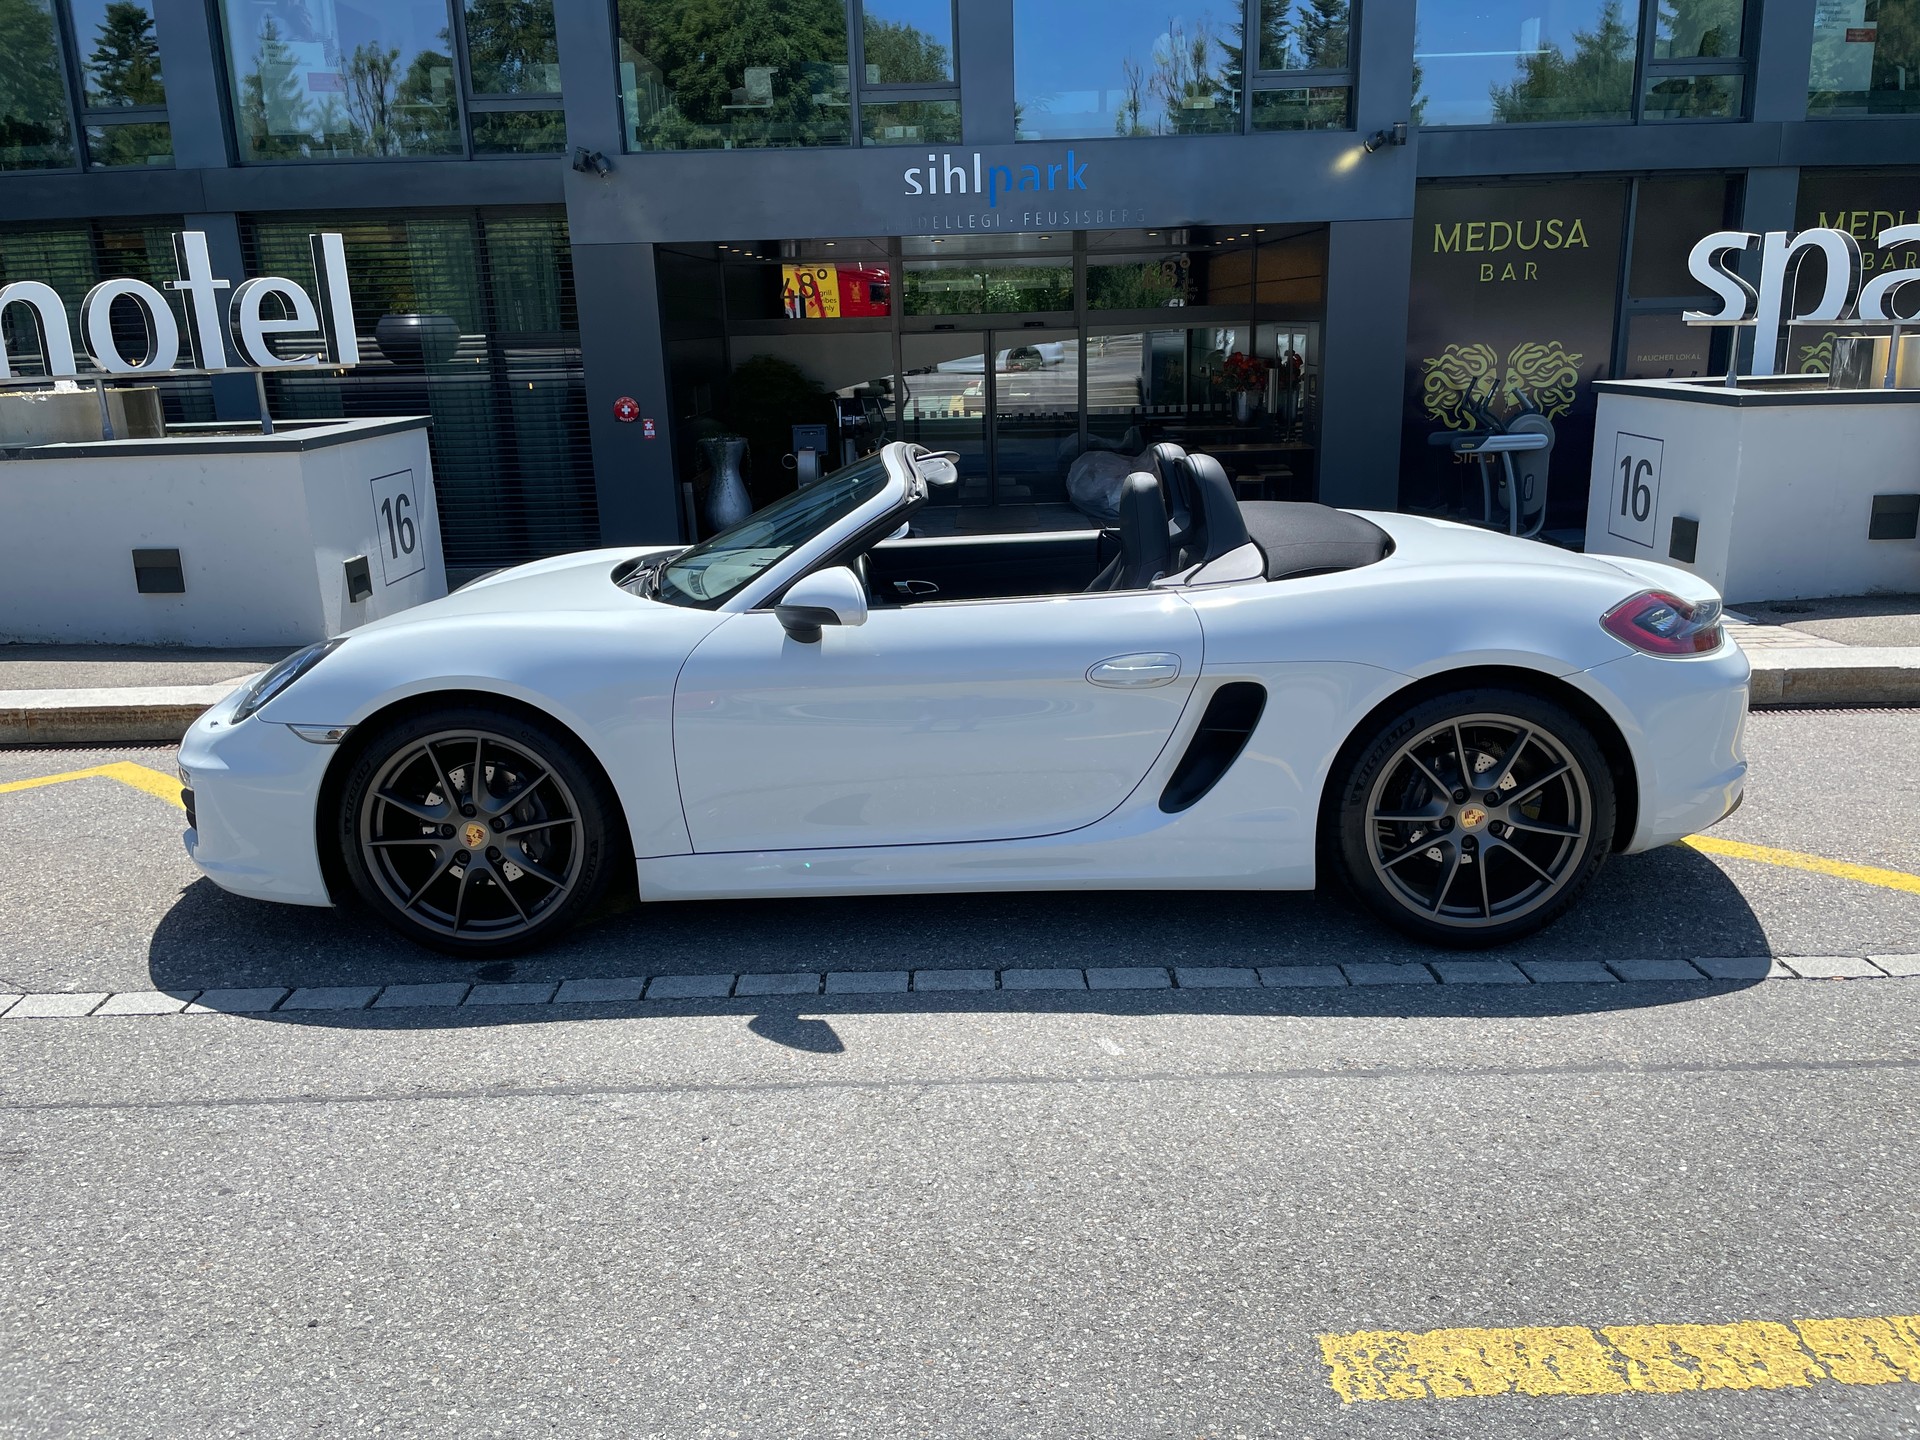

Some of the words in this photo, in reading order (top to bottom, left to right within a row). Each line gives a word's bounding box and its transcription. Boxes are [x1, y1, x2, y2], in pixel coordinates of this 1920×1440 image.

[903, 150, 1089, 208] sihlpark
[1023, 209, 1146, 227] FEUSISBERG
[1433, 218, 1589, 253] MEDUSA
[1479, 262, 1538, 282] BAR
[1862, 251, 1918, 271] BAR
[1637, 354, 1674, 362] RAUCHER
[1620, 455, 1653, 522] 16
[381, 493, 416, 560] 16
